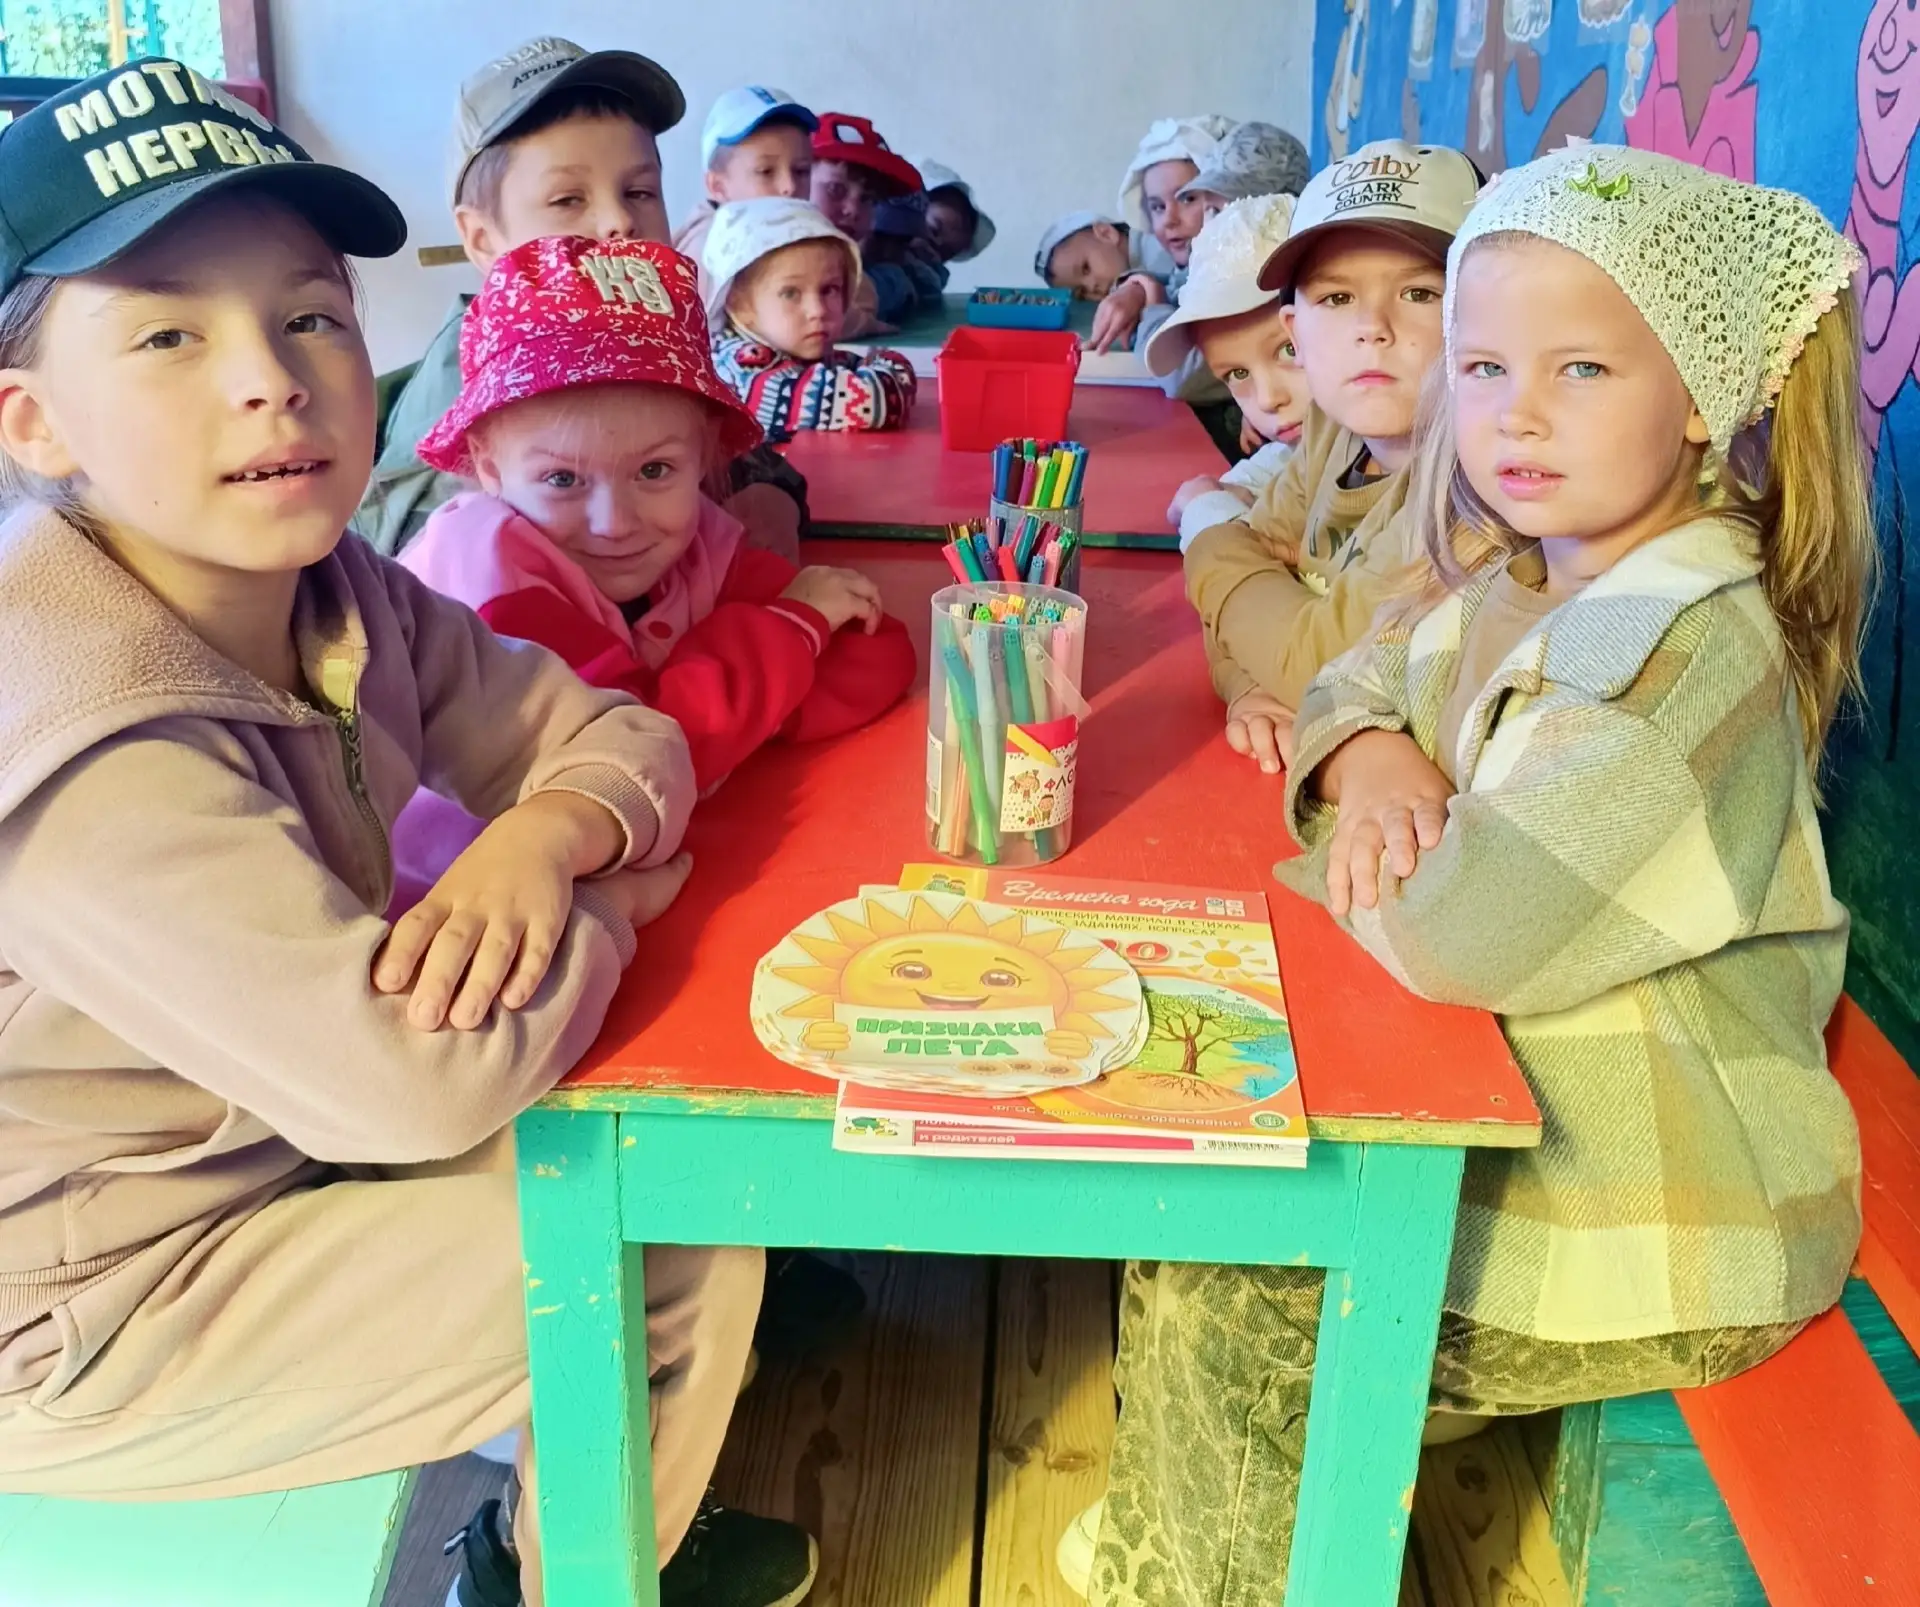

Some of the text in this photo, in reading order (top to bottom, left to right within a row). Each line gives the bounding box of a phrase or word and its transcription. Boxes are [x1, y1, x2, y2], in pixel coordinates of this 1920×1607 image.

[1331, 155, 1421, 188] Colby
[1336, 182, 1404, 201] CLARK
[1334, 193, 1403, 211] COUNTRY
[1002, 880, 1199, 914] Времена года
[1012, 908, 1099, 921] АКТИЧЕСКИЙ
[1105, 914, 1172, 925] МАТЕРИАЛ
[1148, 924, 1216, 936] ВОПРОСАХ
[856, 1018, 1044, 1036] ПРИЗНАКИ
[883, 1039, 1019, 1056] ЛЕТА
[992, 1104, 1036, 1115] ФГОС
[932, 1134, 1016, 1145] родителей
